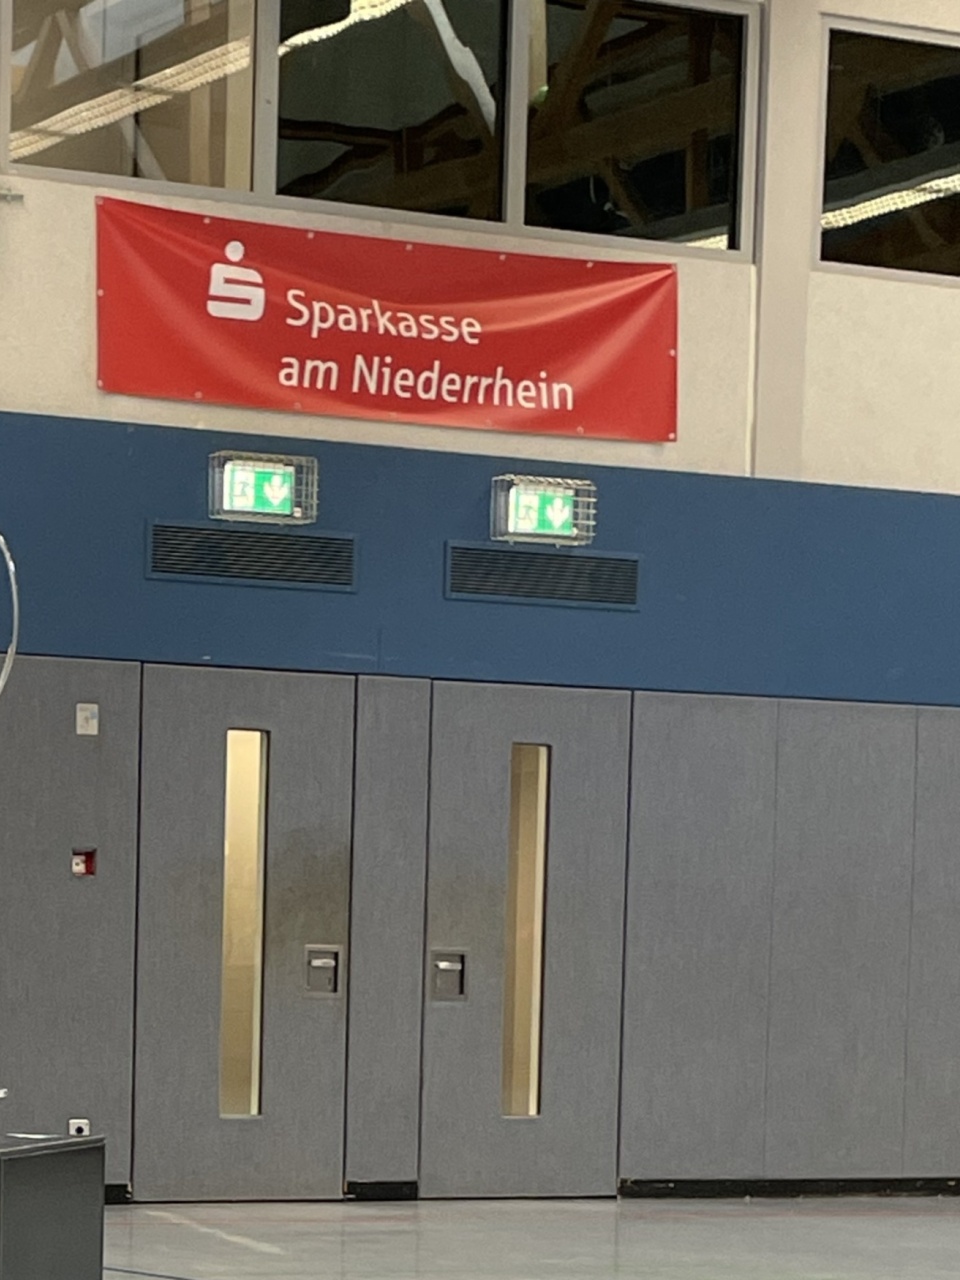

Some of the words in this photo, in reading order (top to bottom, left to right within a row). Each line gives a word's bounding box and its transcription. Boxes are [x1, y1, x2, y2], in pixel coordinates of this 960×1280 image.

[286, 290, 483, 345] Sparkasse
[278, 355, 339, 391] am
[351, 354, 574, 411] Niederrhein
